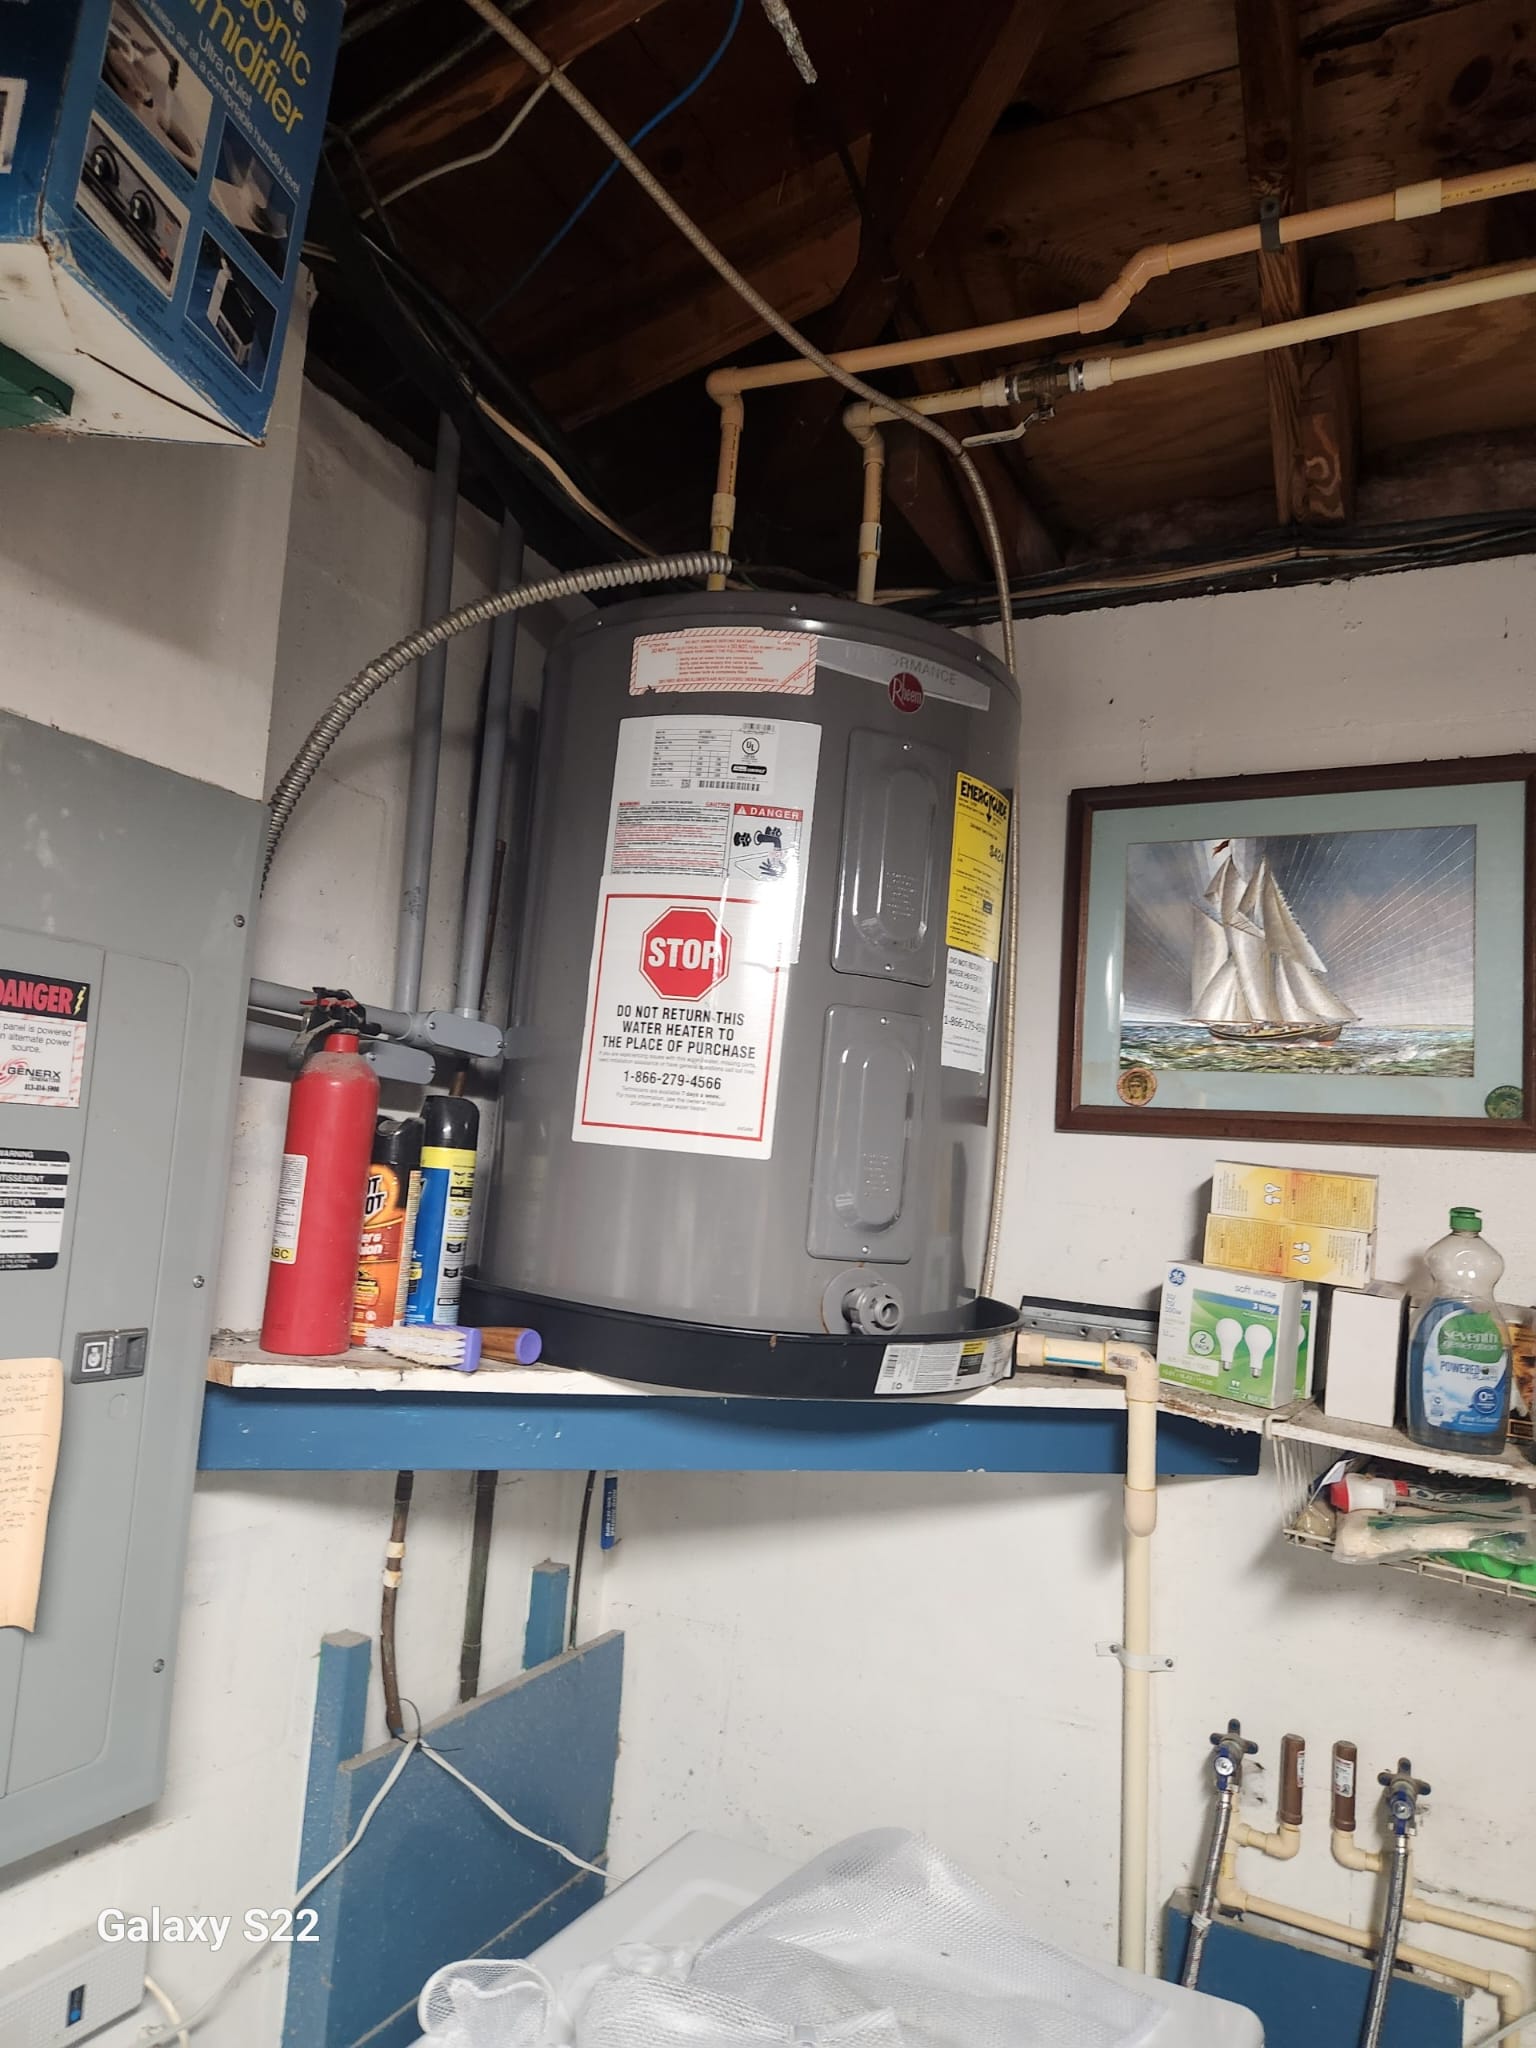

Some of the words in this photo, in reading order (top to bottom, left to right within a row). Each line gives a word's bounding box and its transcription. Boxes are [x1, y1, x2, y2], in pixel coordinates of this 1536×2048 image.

[891, 673, 922, 706] Rheem
[750, 808, 800, 820] DANGER
[648, 936, 722, 971] STOP
[617, 1004, 632, 1018] DO
[635, 1005, 659, 1020] NOT
[662, 1006, 712, 1023] RETURN
[716, 1011, 745, 1026] THIS
[3, 1022, 27, 1033] panel
[28, 1025, 35, 1033] is
[37, 1026, 72, 1037] powered
[622, 1020, 662, 1036] WATER
[666, 1023, 714, 1040] HEATER
[719, 1027, 735, 1042] TO
[9, 1033, 45, 1045] alternate
[45, 1037, 70, 1047] power
[602, 1035, 622, 1049] THE
[626, 1036, 664, 1053] PLACE
[667, 1039, 684, 1053] OF
[687, 1041, 756, 1060] PURCHASE
[7, 1066, 62, 1079] GENERX
[623, 1069, 722, 1090] 1-866-279-4566
[1234, 1284, 1251, 1295] soft
[1252, 1288, 1278, 1299] white
[1199, 1333, 1207, 1344] 2
[1440, 1360, 1481, 1375] POWERED
